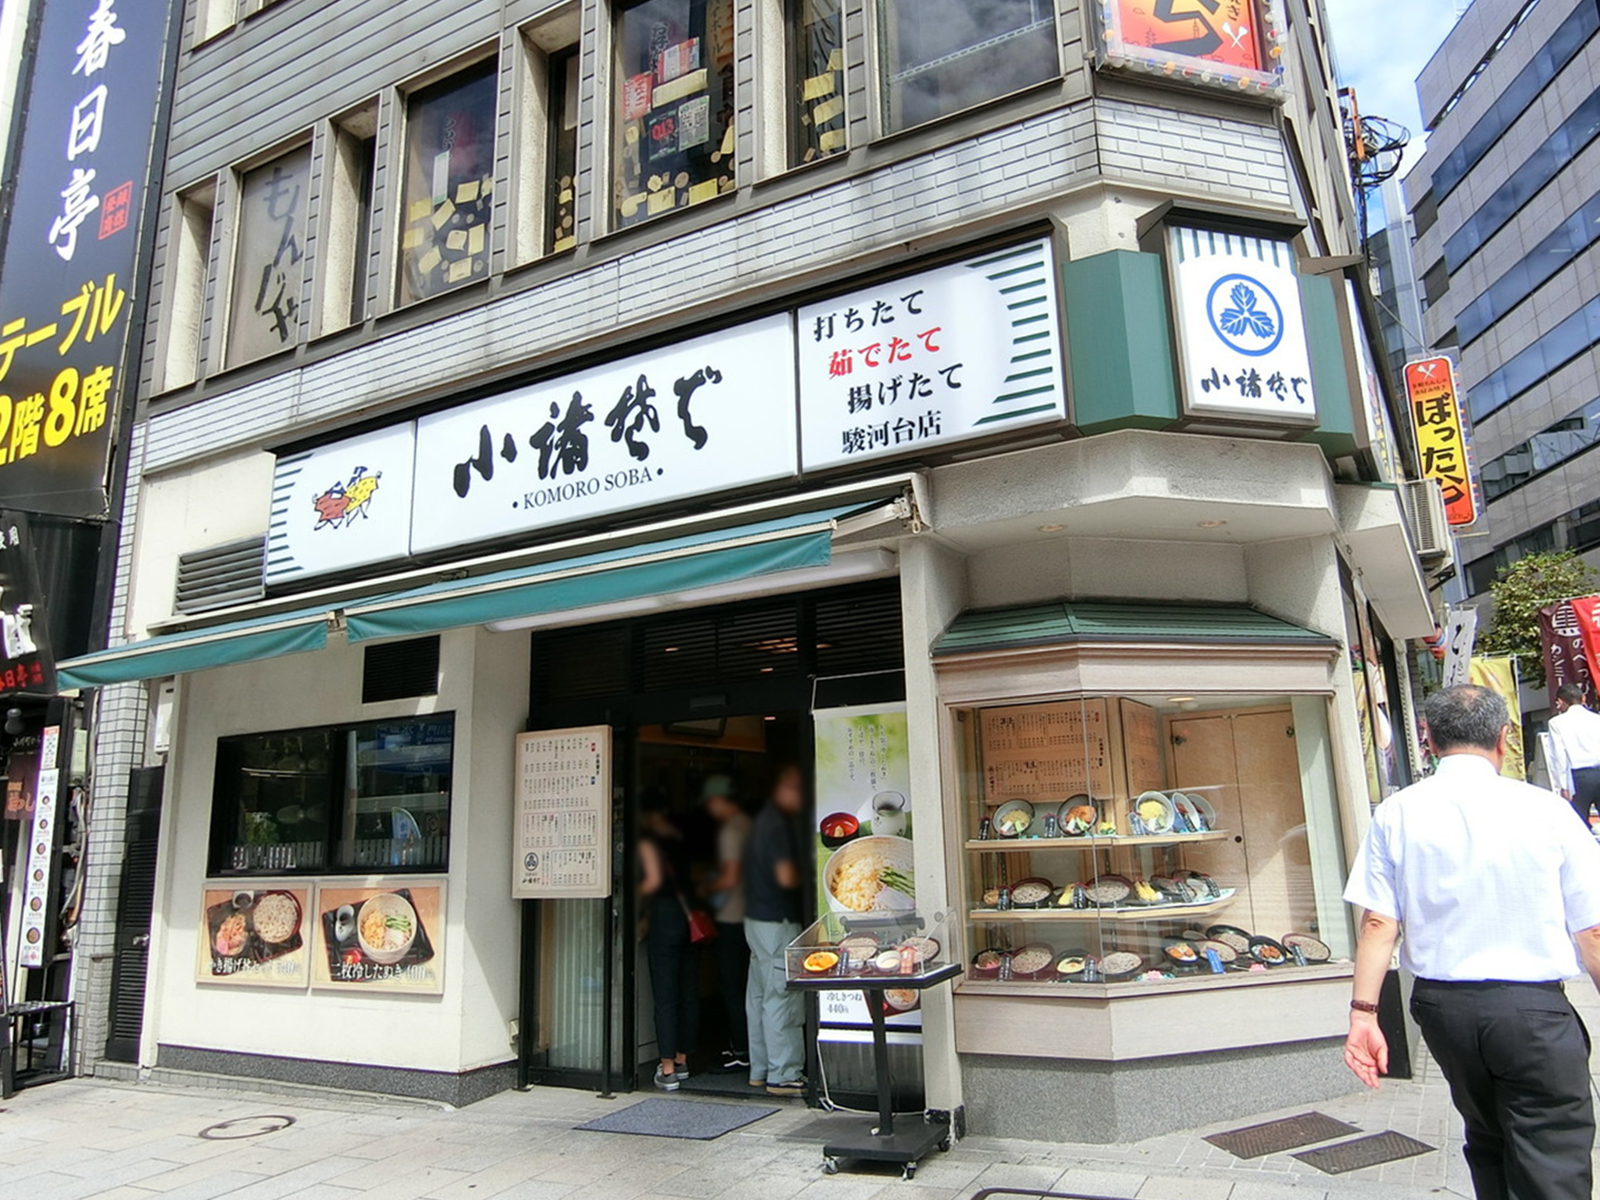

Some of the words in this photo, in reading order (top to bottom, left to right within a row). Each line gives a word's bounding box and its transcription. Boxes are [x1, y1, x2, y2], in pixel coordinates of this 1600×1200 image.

[48, 0, 127, 261] 春日亭
[255, 166, 304, 343] もんじゃ
[813, 289, 924, 342] 打ちたて
[828, 326, 942, 379] 茹でたて
[847, 362, 963, 414] 揚げたて
[841, 409, 942, 454] 駿河台店
[523, 478, 600, 510] KOMORO
[604, 466, 652, 492] SOBA
[826, 991, 863, 1002] 冷しきつね
